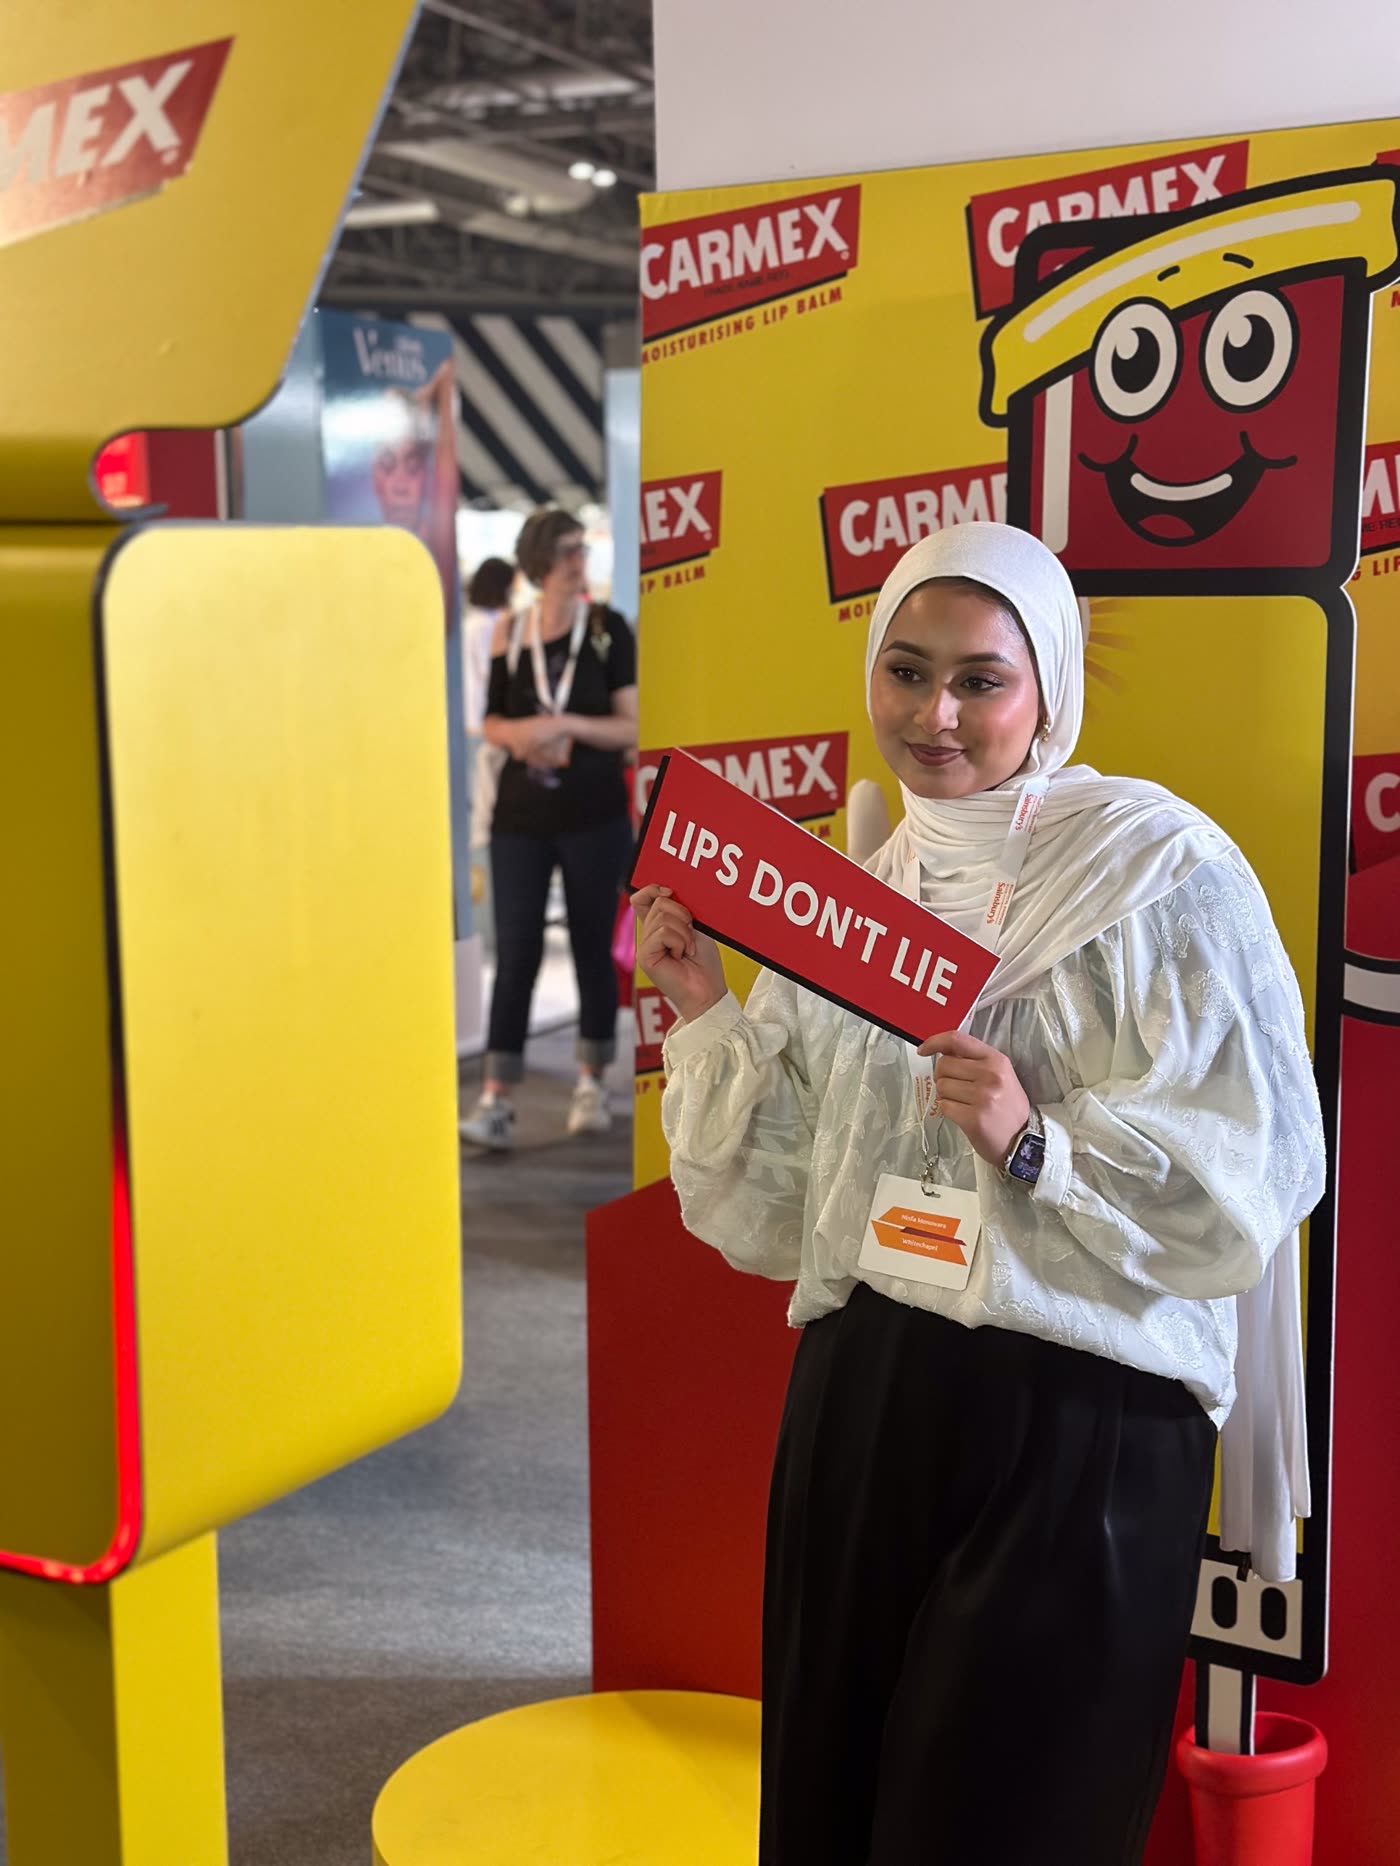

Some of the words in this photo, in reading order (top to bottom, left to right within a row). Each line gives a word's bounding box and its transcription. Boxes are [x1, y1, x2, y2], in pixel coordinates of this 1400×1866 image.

[640, 197, 848, 299] CARMEX
[763, 304, 788, 325] LIP
[797, 287, 842, 315] BALM
[640, 481, 711, 544] EX
[663, 565, 705, 588] BALM
[1015, 793, 1034, 832] Sainsbury's
[659, 810, 744, 887] LIPS
[748, 859, 888, 964] DON'T
[890, 936, 958, 1006] LIE
[986, 881, 1006, 924] Sainsbury's
